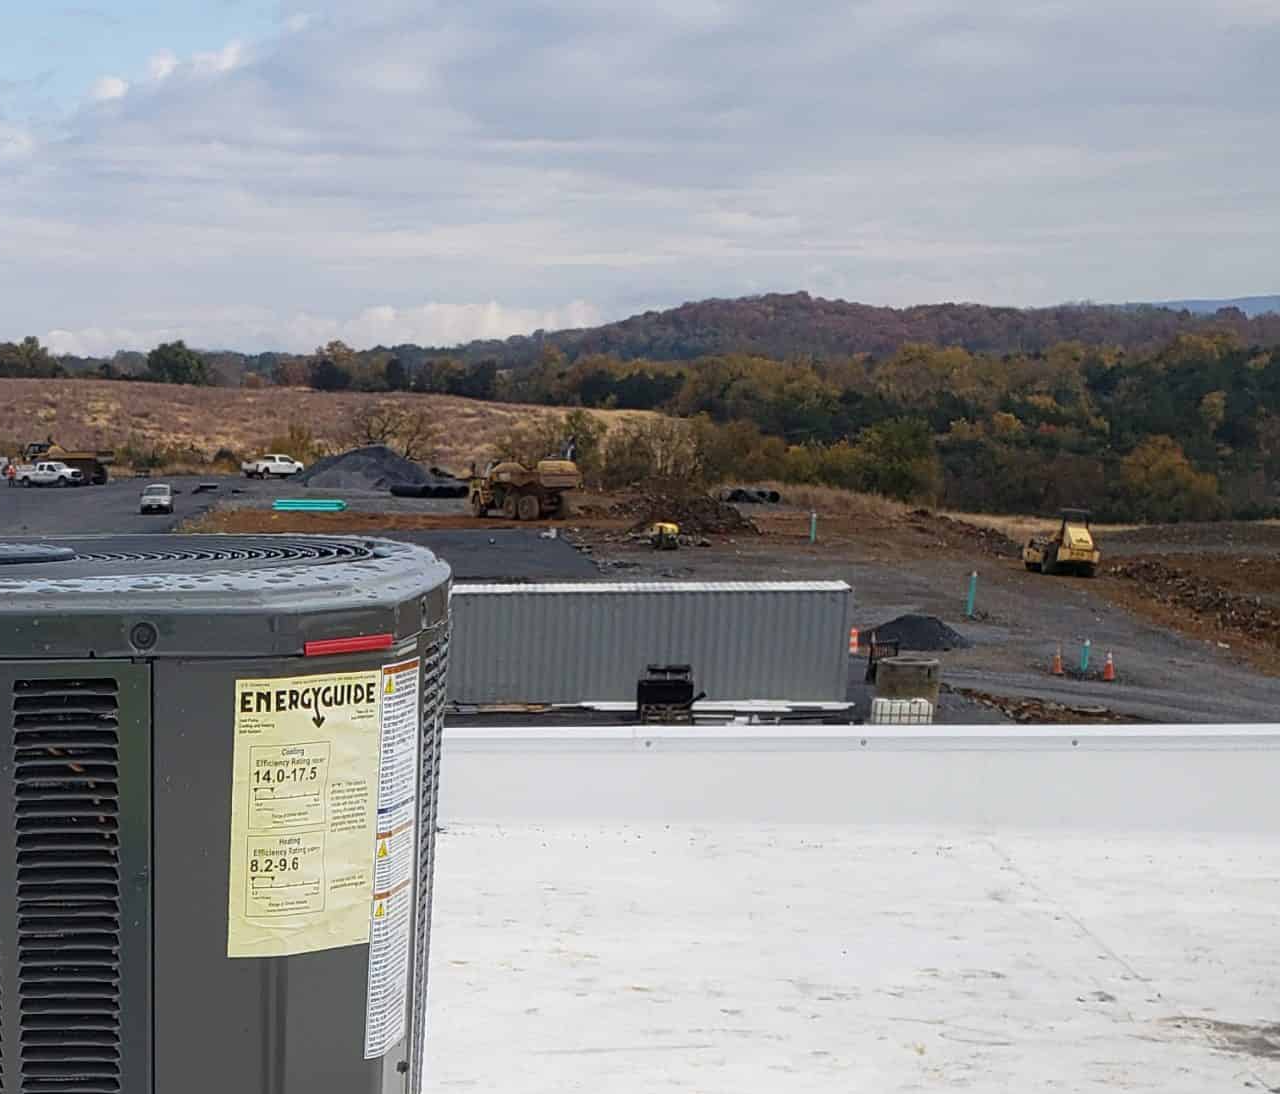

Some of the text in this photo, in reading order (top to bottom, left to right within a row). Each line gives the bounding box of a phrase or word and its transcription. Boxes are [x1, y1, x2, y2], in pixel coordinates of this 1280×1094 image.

[240, 683, 376, 715] ENERGYGUIDE
[256, 759, 290, 767] Efficiency
[291, 757, 311, 766] Rating
[254, 767, 318, 783] 14.0-17.5
[253, 848, 287, 857] Efficiency
[288, 847, 306, 855] Rating
[250, 857, 299, 873] 8.2-9.6
